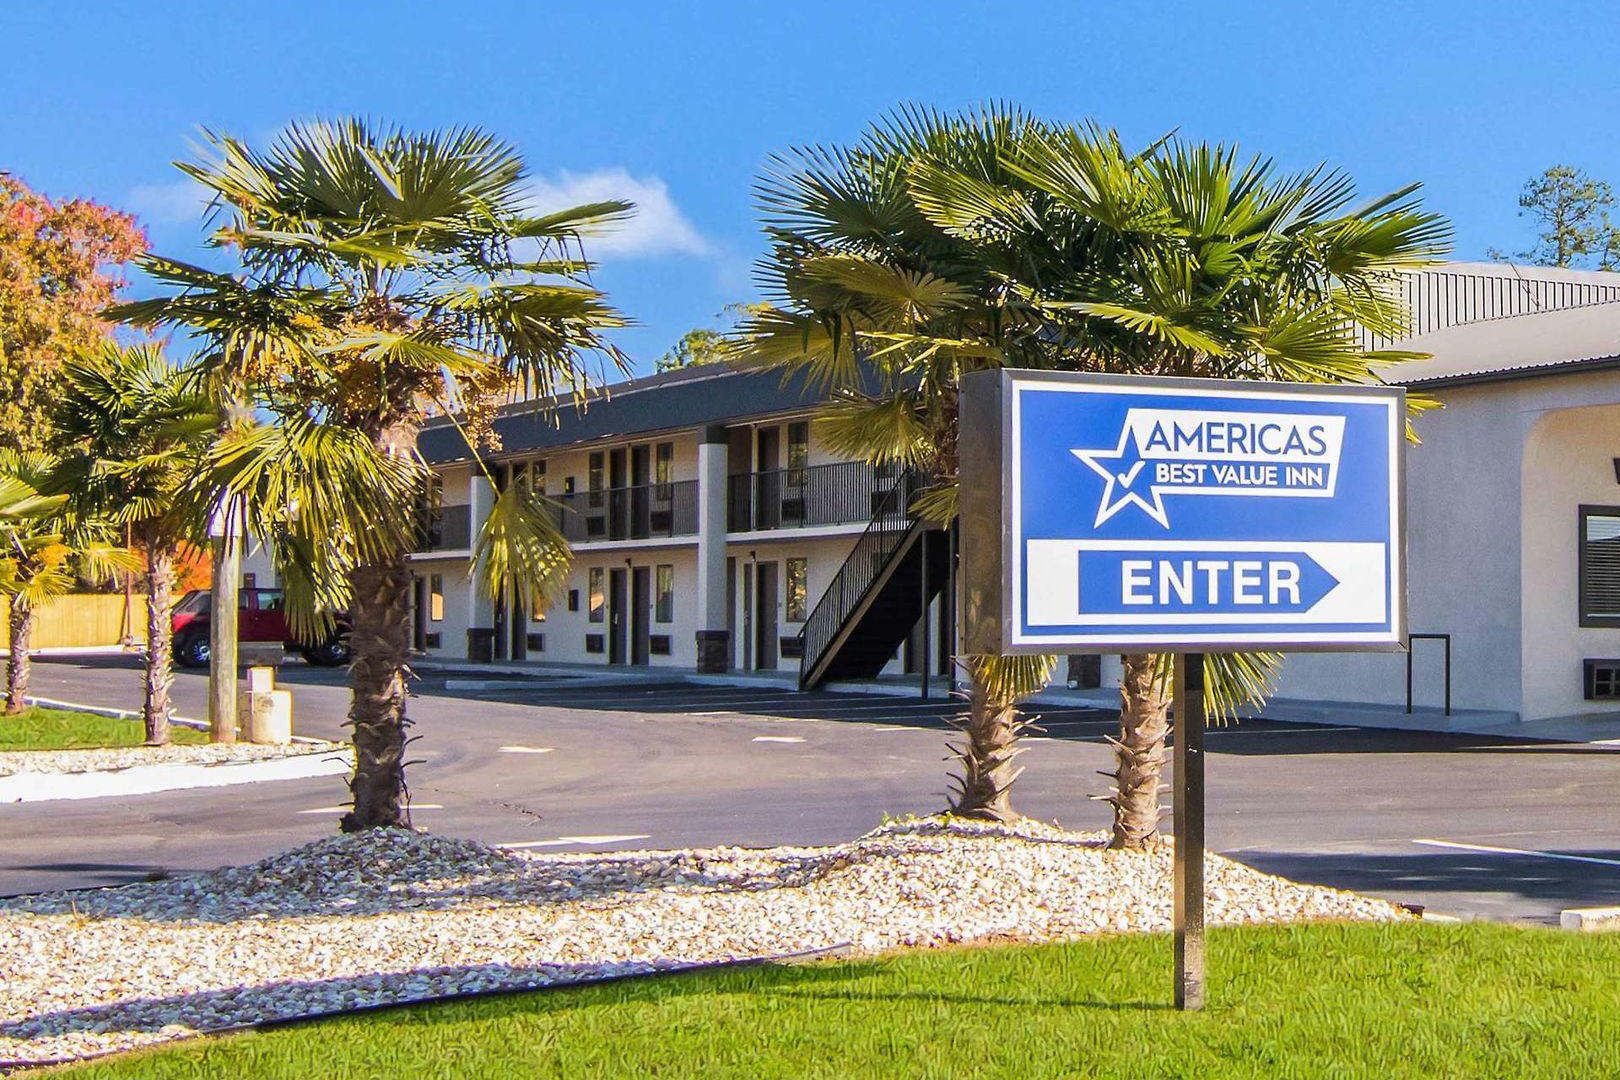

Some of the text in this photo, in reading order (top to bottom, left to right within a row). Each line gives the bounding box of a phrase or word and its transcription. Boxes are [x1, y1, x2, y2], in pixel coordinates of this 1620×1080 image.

[1145, 420, 1327, 456] AMERICAS
[1156, 463, 1323, 487] BEST VALUE INN
[1121, 560, 1301, 605] ENTER
